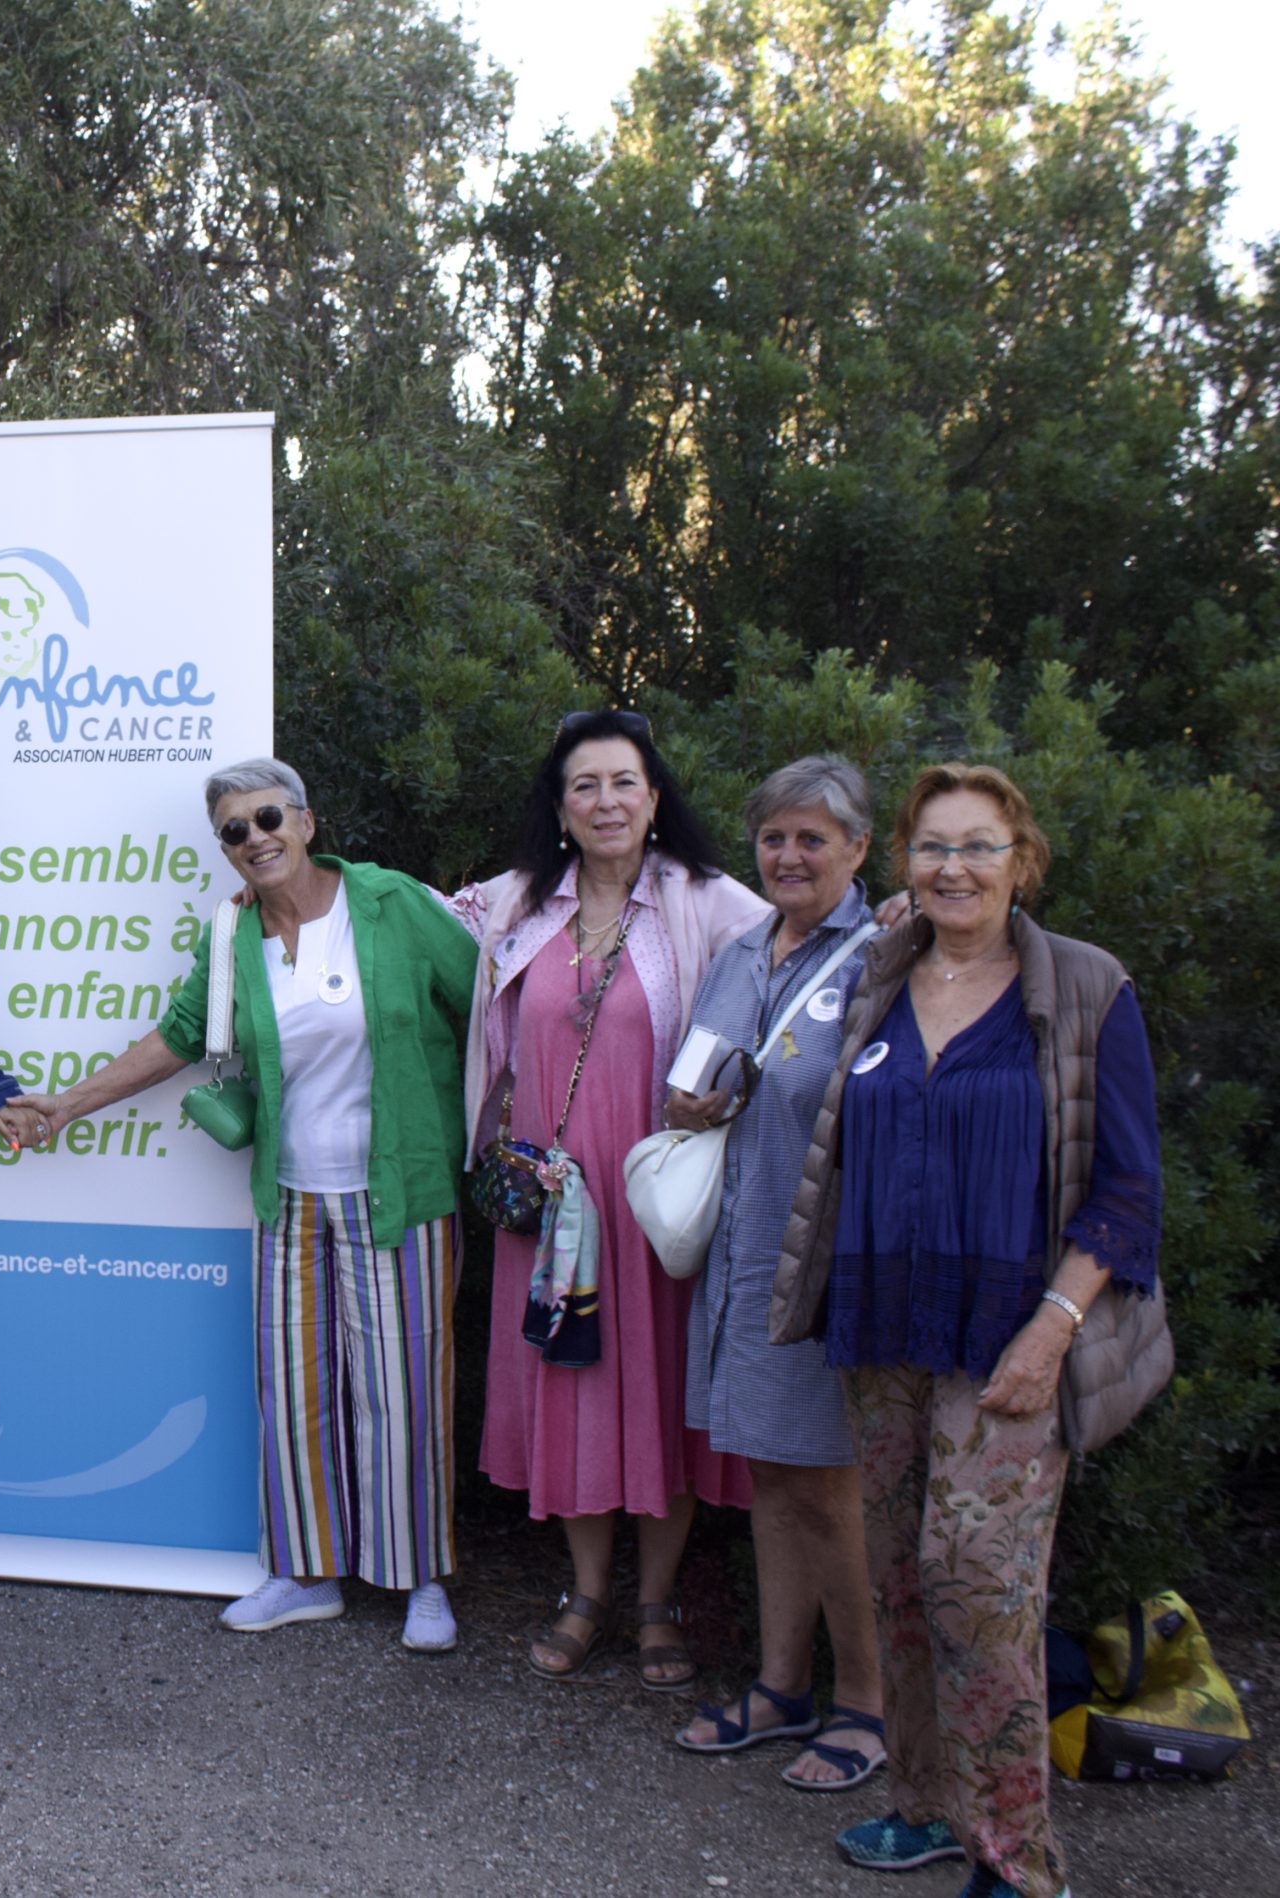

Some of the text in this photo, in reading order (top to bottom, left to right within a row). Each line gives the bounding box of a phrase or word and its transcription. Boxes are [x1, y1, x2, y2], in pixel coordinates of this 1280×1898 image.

[14, 716, 213, 742] & CANCER
[13, 747, 213, 763] ASSOCIATION HUBERT GOUIN
[170, 901, 201, 953] à
